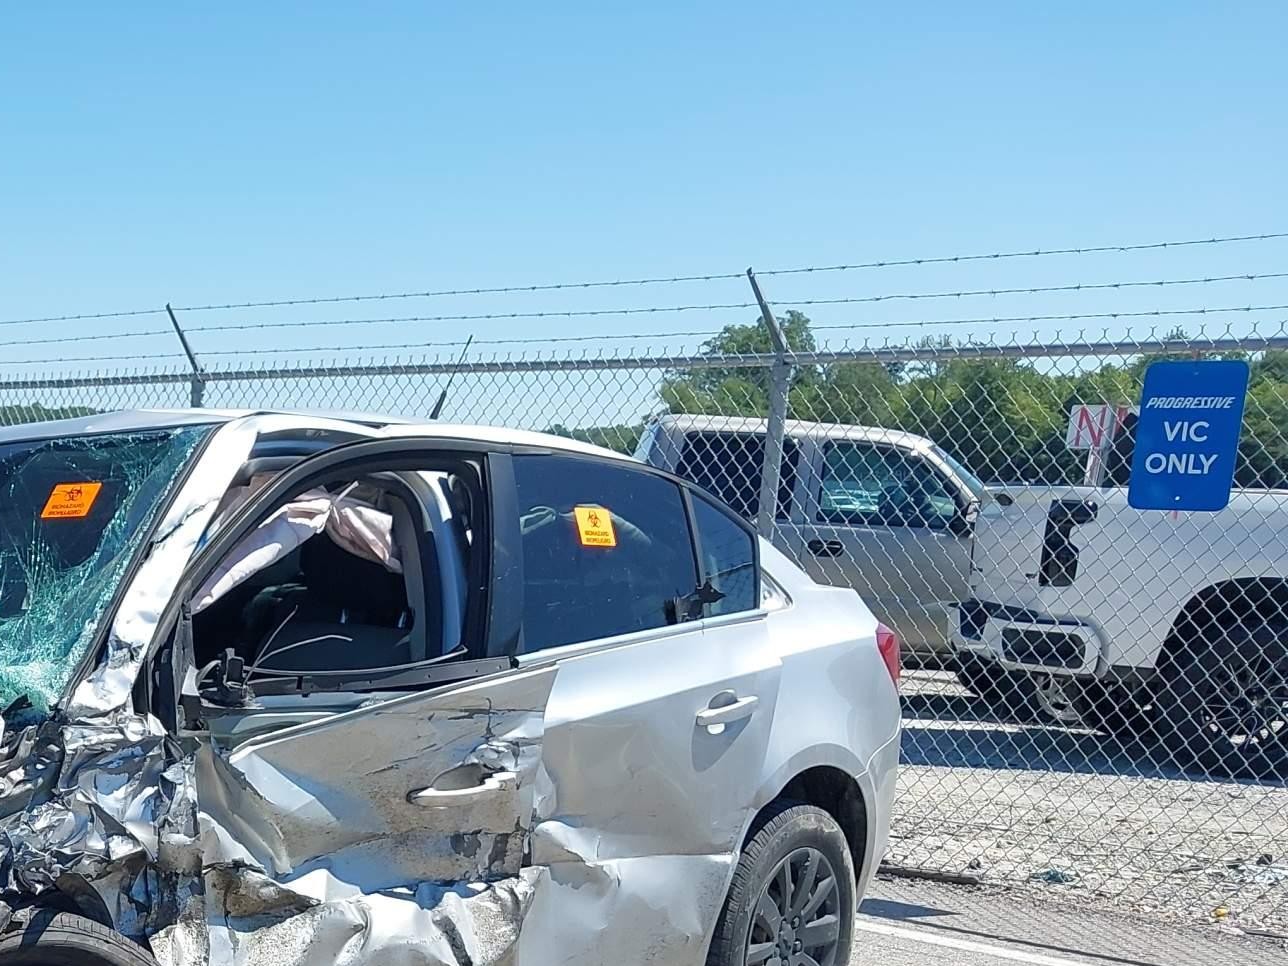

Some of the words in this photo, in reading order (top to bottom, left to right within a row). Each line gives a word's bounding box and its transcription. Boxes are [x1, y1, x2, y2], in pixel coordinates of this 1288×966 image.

[1146, 396, 1236, 409] PROGRESSIVE
[1164, 421, 1210, 443] VIC
[1145, 453, 1219, 475] ONLY
